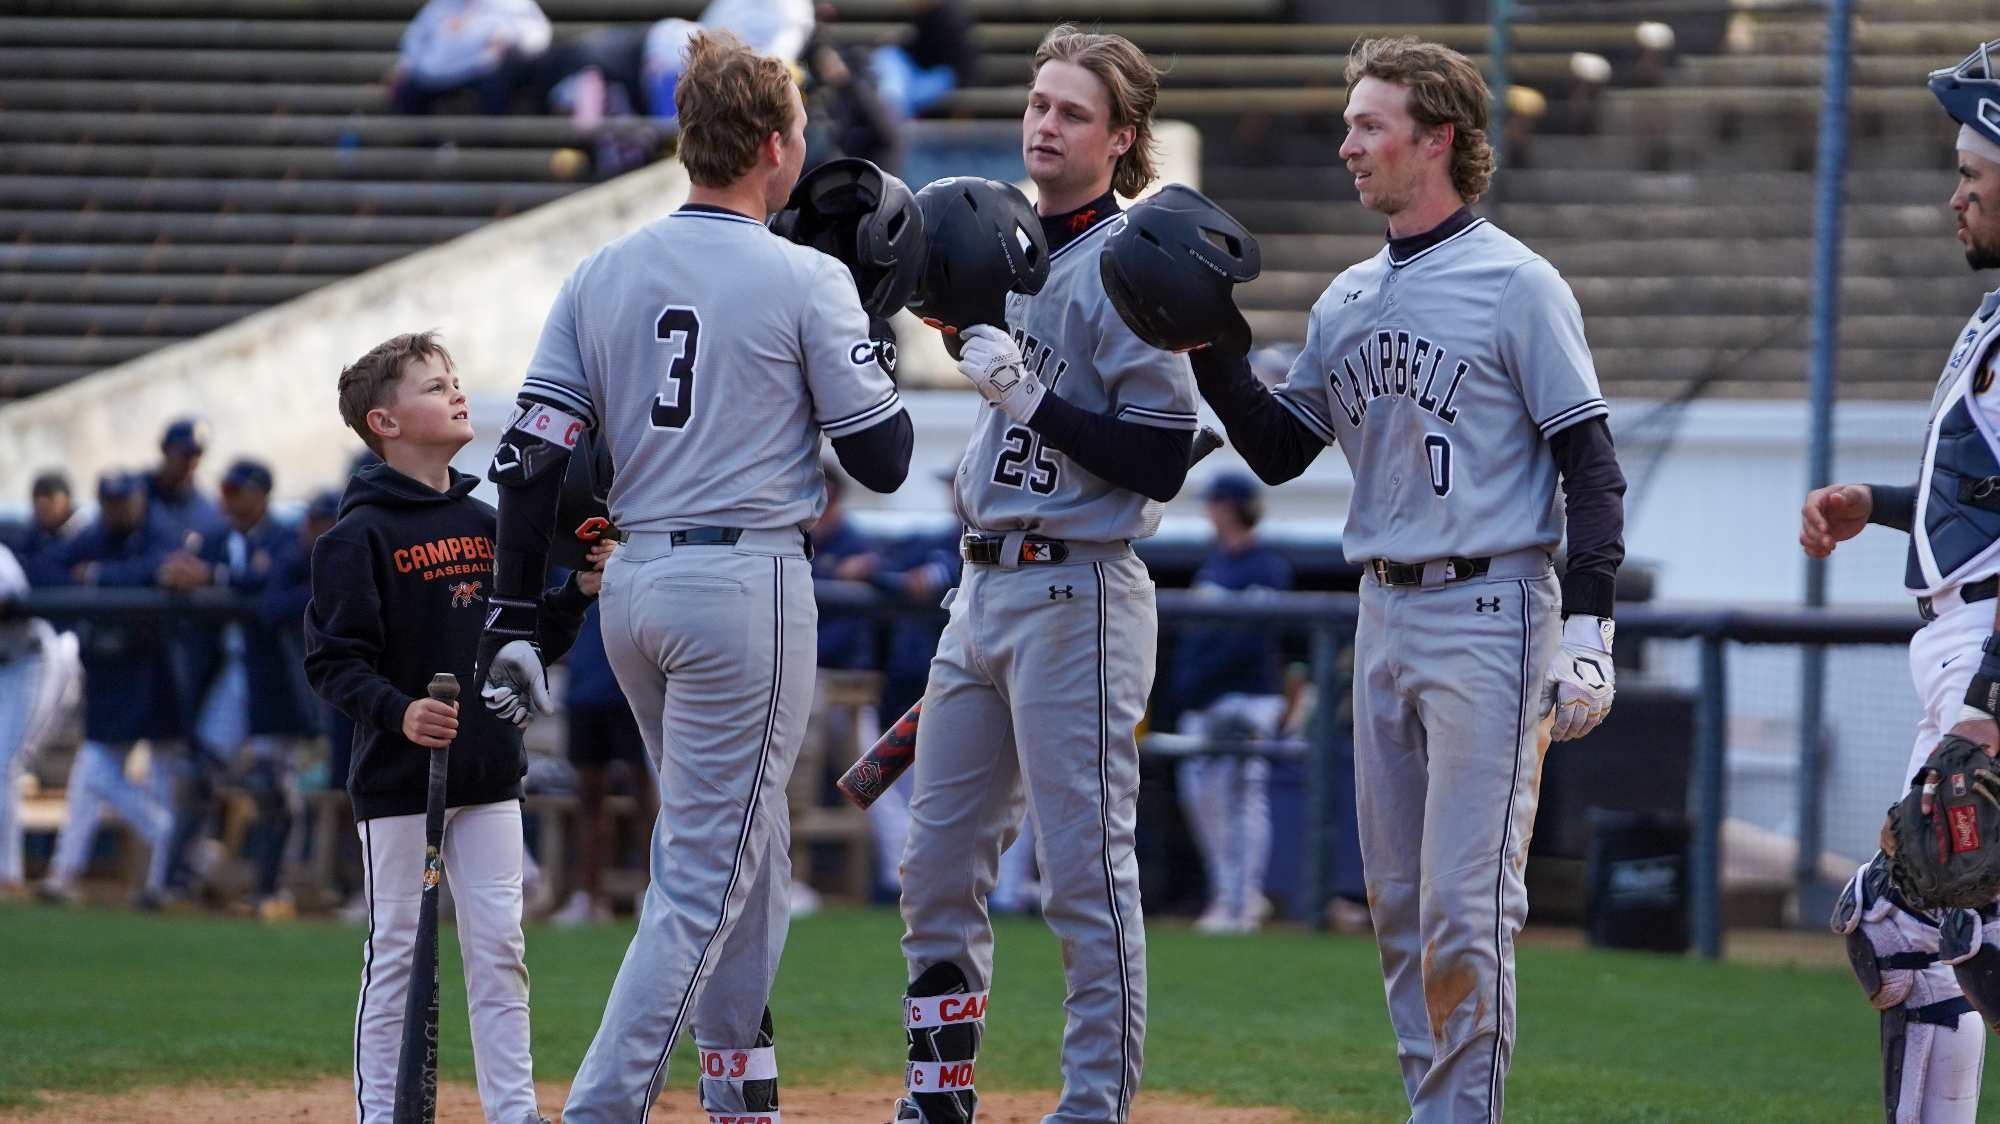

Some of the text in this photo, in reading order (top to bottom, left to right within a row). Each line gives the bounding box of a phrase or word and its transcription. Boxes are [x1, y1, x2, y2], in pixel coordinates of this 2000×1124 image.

[1189, 249, 1228, 277] EVOSHIELD
[649, 304, 702, 432] 3
[1329, 329, 1470, 428] CAMPBELL
[536, 414, 550, 430] C
[564, 421, 585, 446] C
[990, 424, 1060, 497] 25
[1423, 432, 1453, 499] 0
[575, 517, 609, 540] C
[393, 536, 496, 573] CAMPBEL
[423, 562, 493, 580] BASEBALL
[912, 1006, 921, 1021] C
[914, 1069, 923, 1085] C
[939, 1063, 976, 1088] MO
